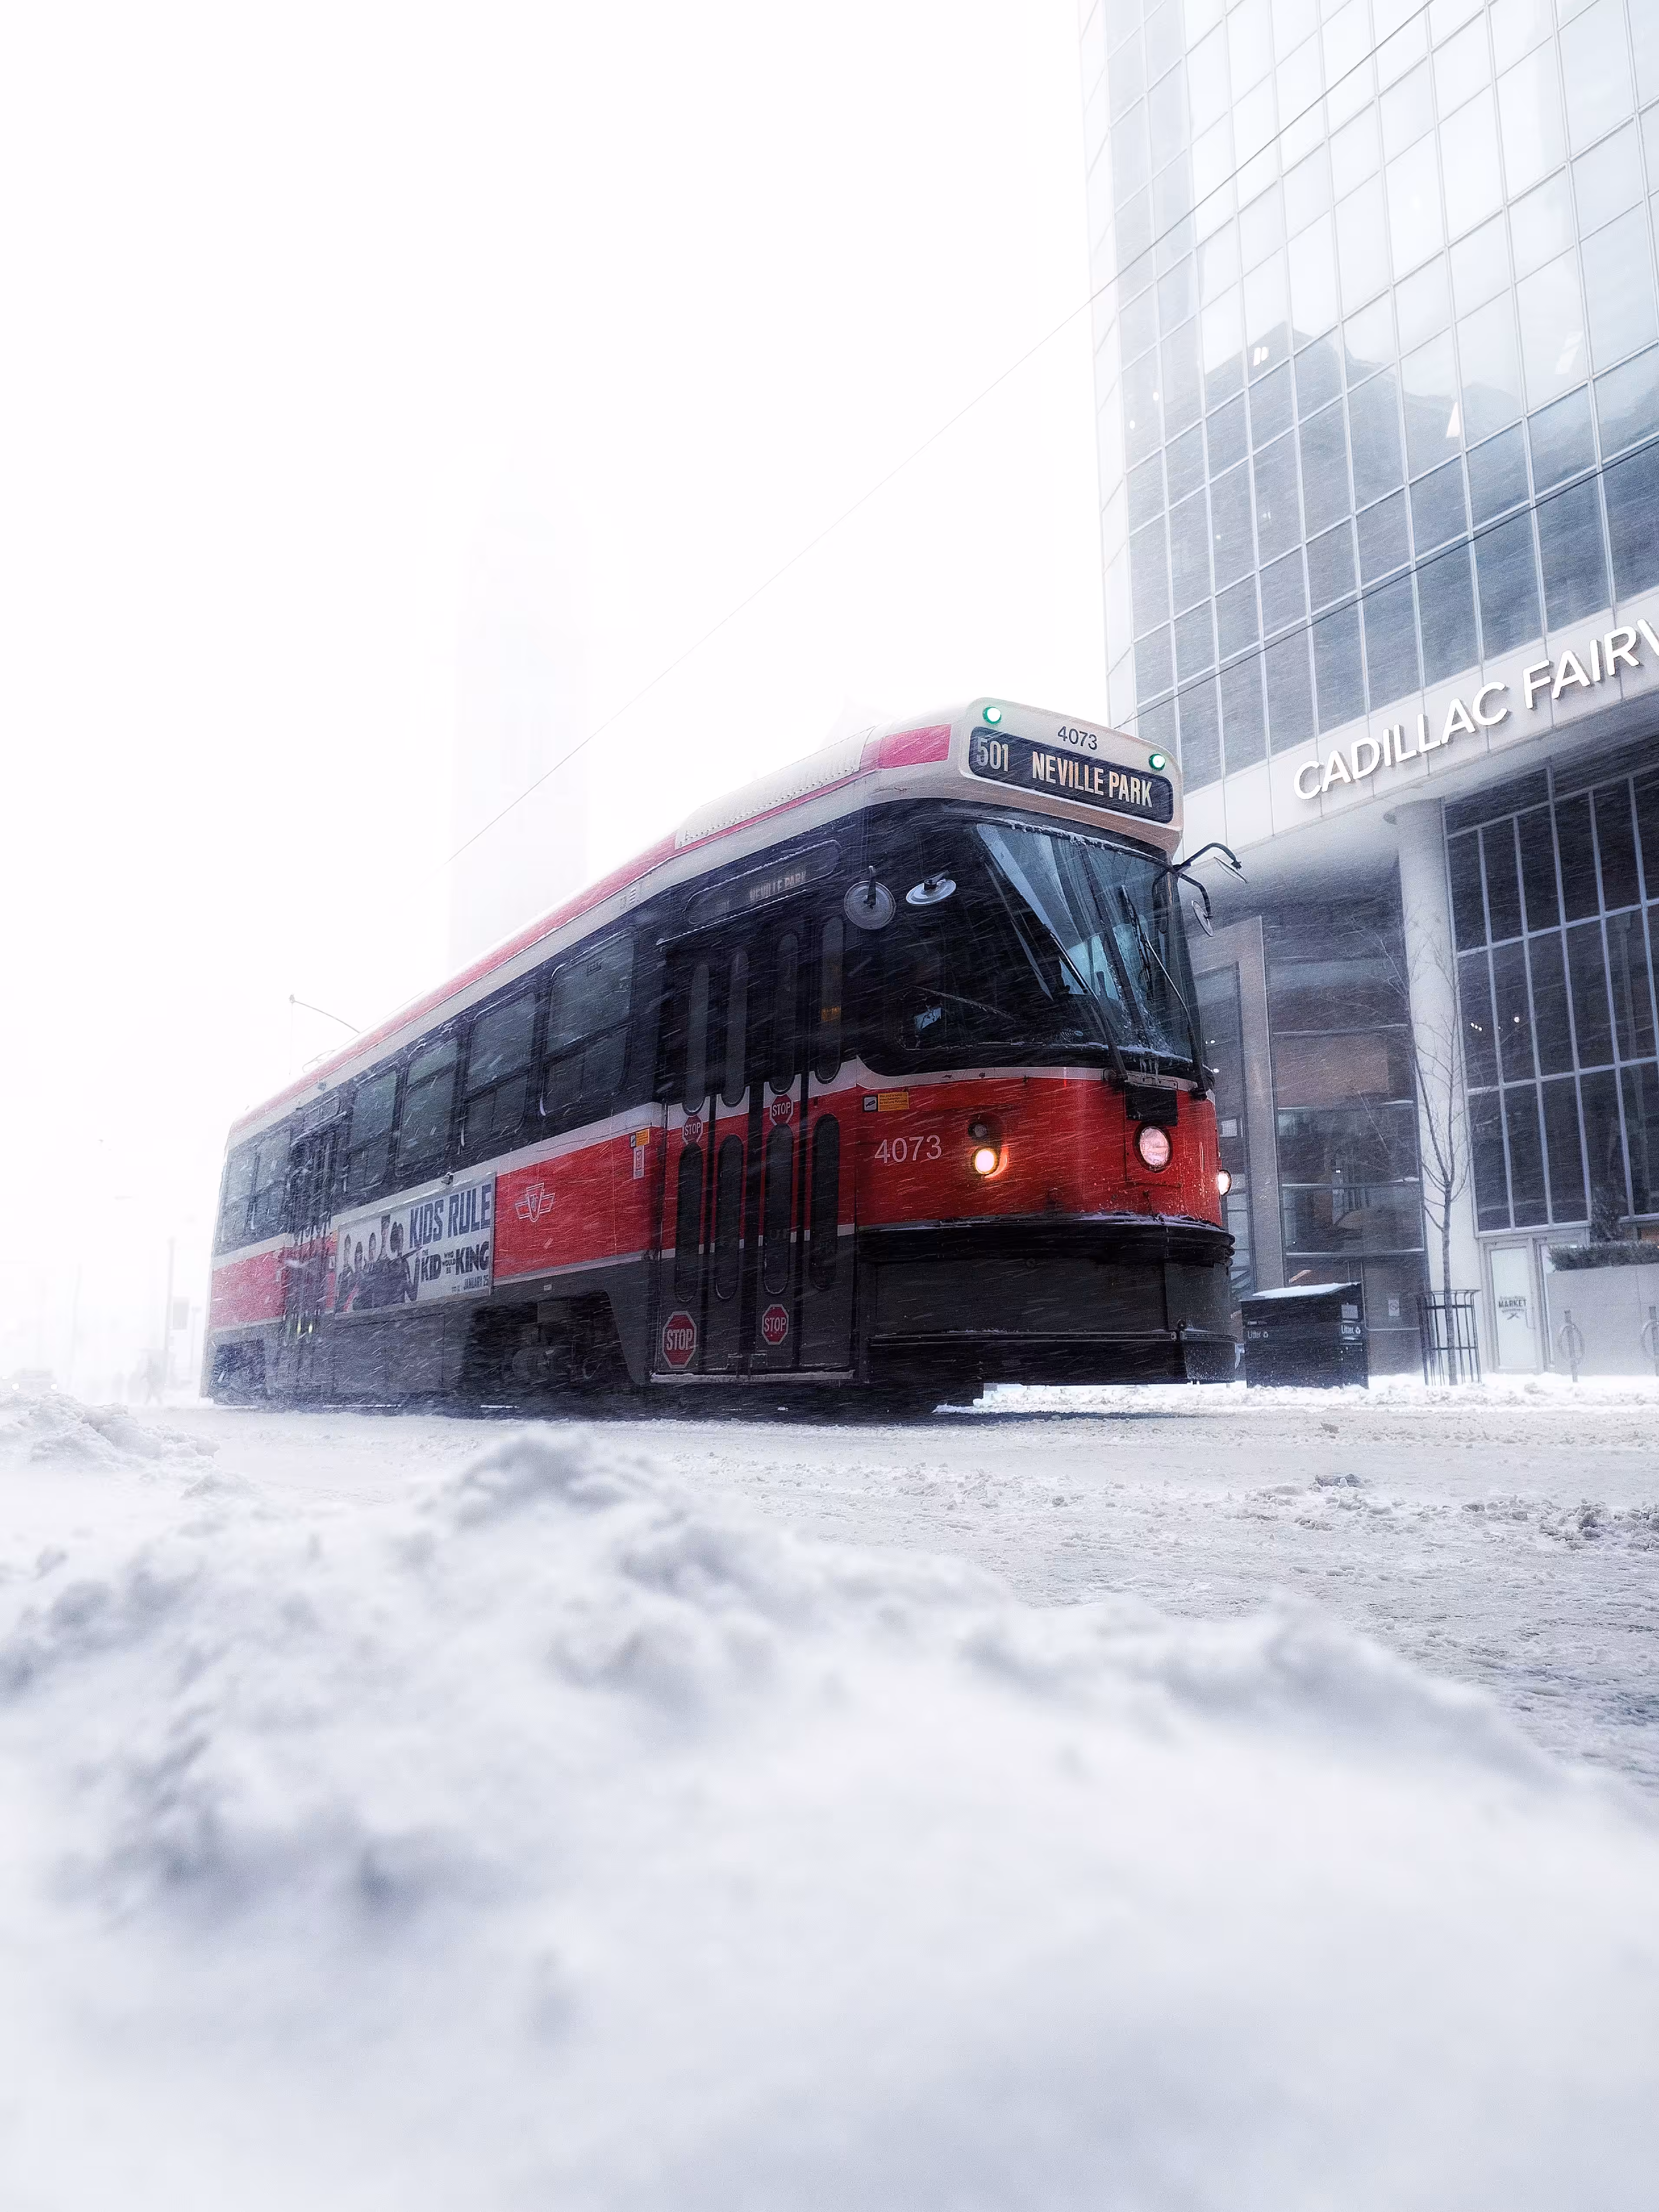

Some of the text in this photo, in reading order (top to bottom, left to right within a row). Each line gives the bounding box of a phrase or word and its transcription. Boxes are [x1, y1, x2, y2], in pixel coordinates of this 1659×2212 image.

[1057, 725, 1098, 751] 4073
[1293, 680, 1509, 800] CADILLAC
[977, 737, 1153, 807] 501 NEVILLE PARK
[772, 1102, 791, 1116] STOP
[685, 1122, 701, 1136] STOP
[874, 1134, 942, 1164] 4073
[410, 1184, 491, 1248] KIDS RULE
[421, 1254, 442, 1283] KID
[456, 1241, 489, 1275] KING
[1499, 1300, 1526, 1308] MARKET
[764, 1317, 786, 1332] STOP
[1248, 1330, 1261, 1339] Litter
[1341, 1325, 1354, 1335] Litter
[666, 1329, 693, 1351] STOP
